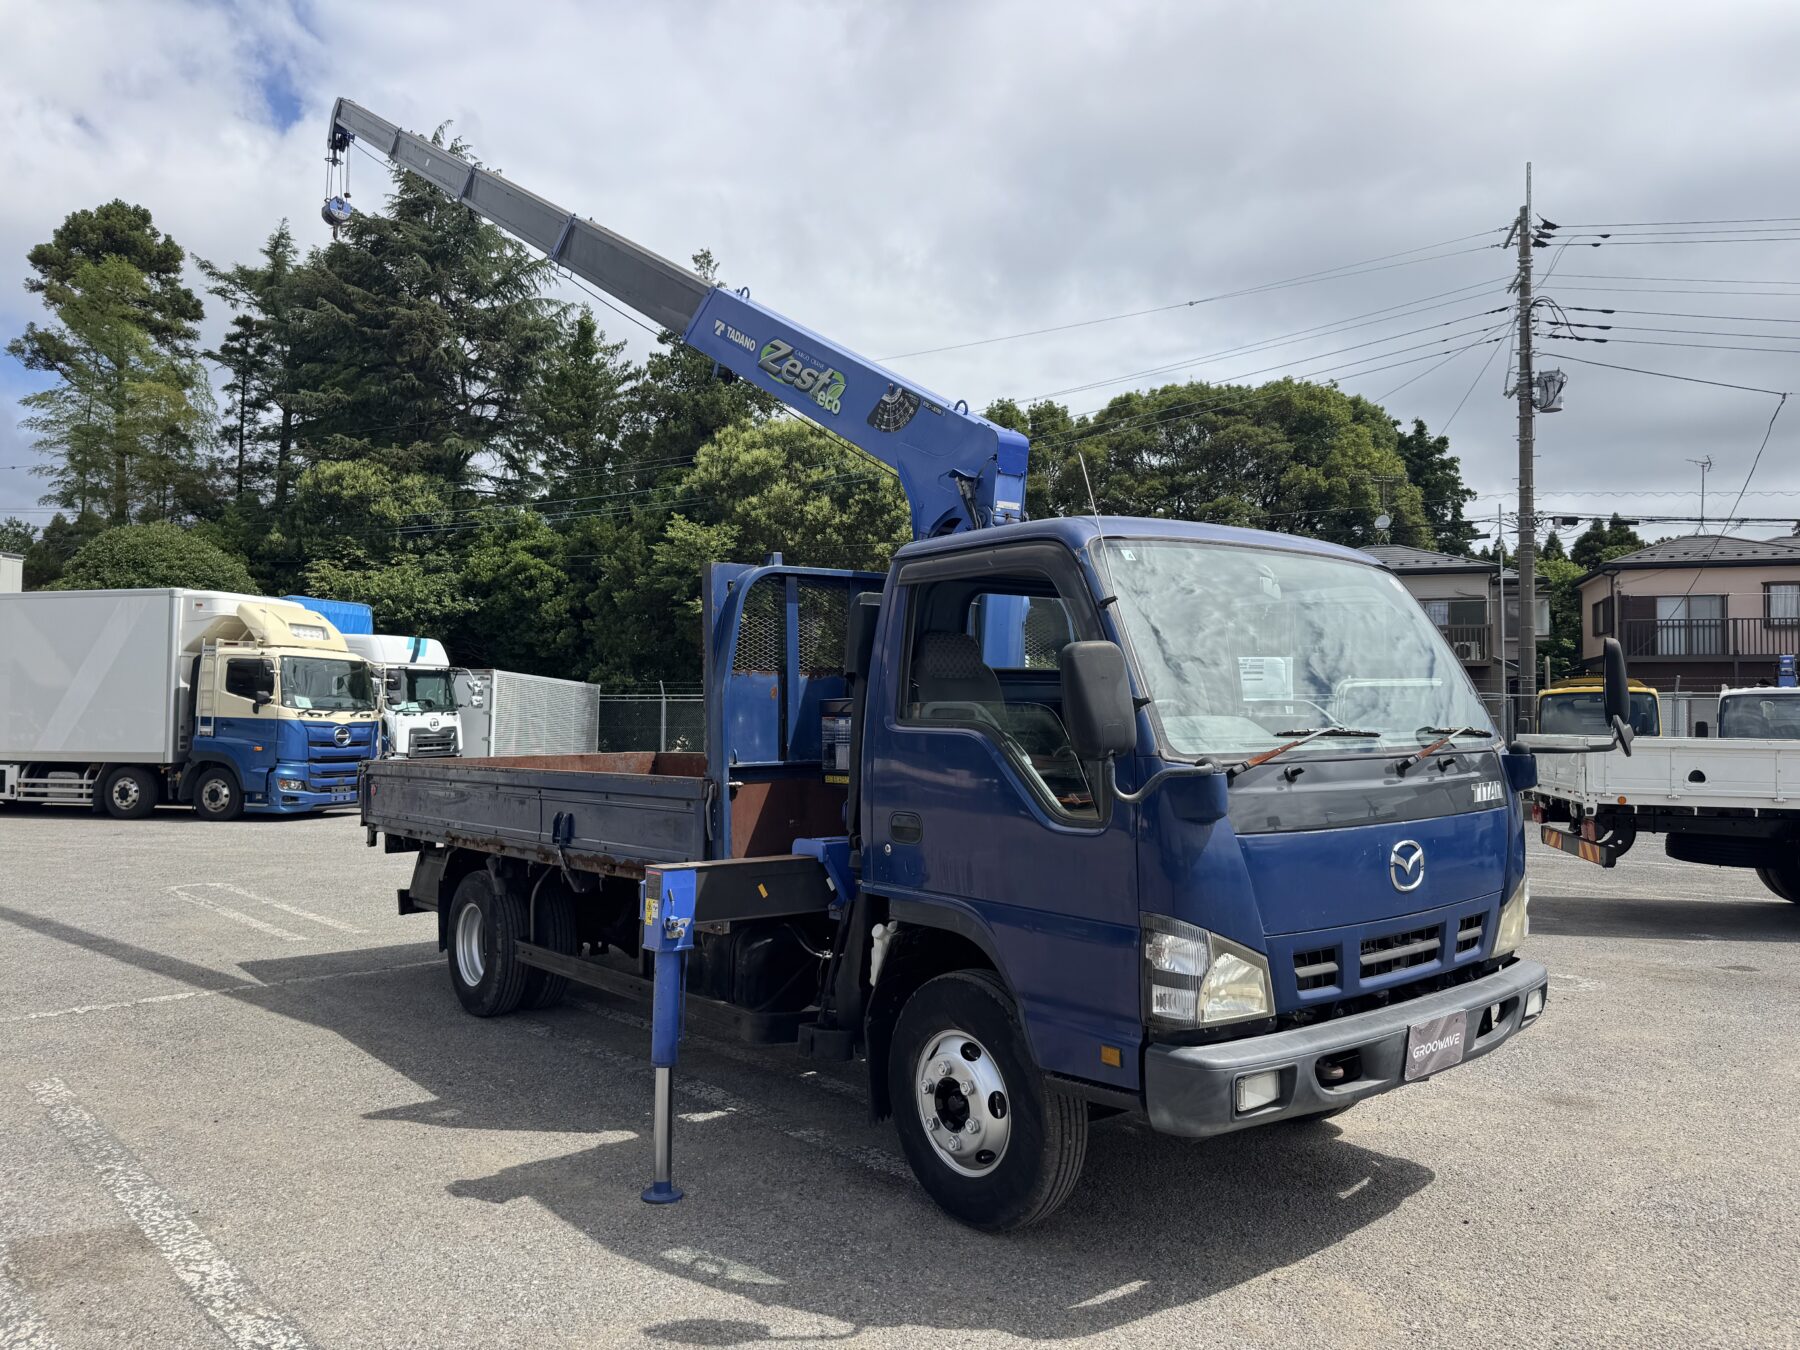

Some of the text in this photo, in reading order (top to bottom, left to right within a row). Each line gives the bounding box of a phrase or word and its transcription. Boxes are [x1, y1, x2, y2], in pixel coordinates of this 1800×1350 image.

[727, 325, 756, 352] TADANO
[758, 339, 834, 399] Zest
[817, 391, 841, 415] eco
[1412, 1032, 1461, 1059] GROOWAVE
